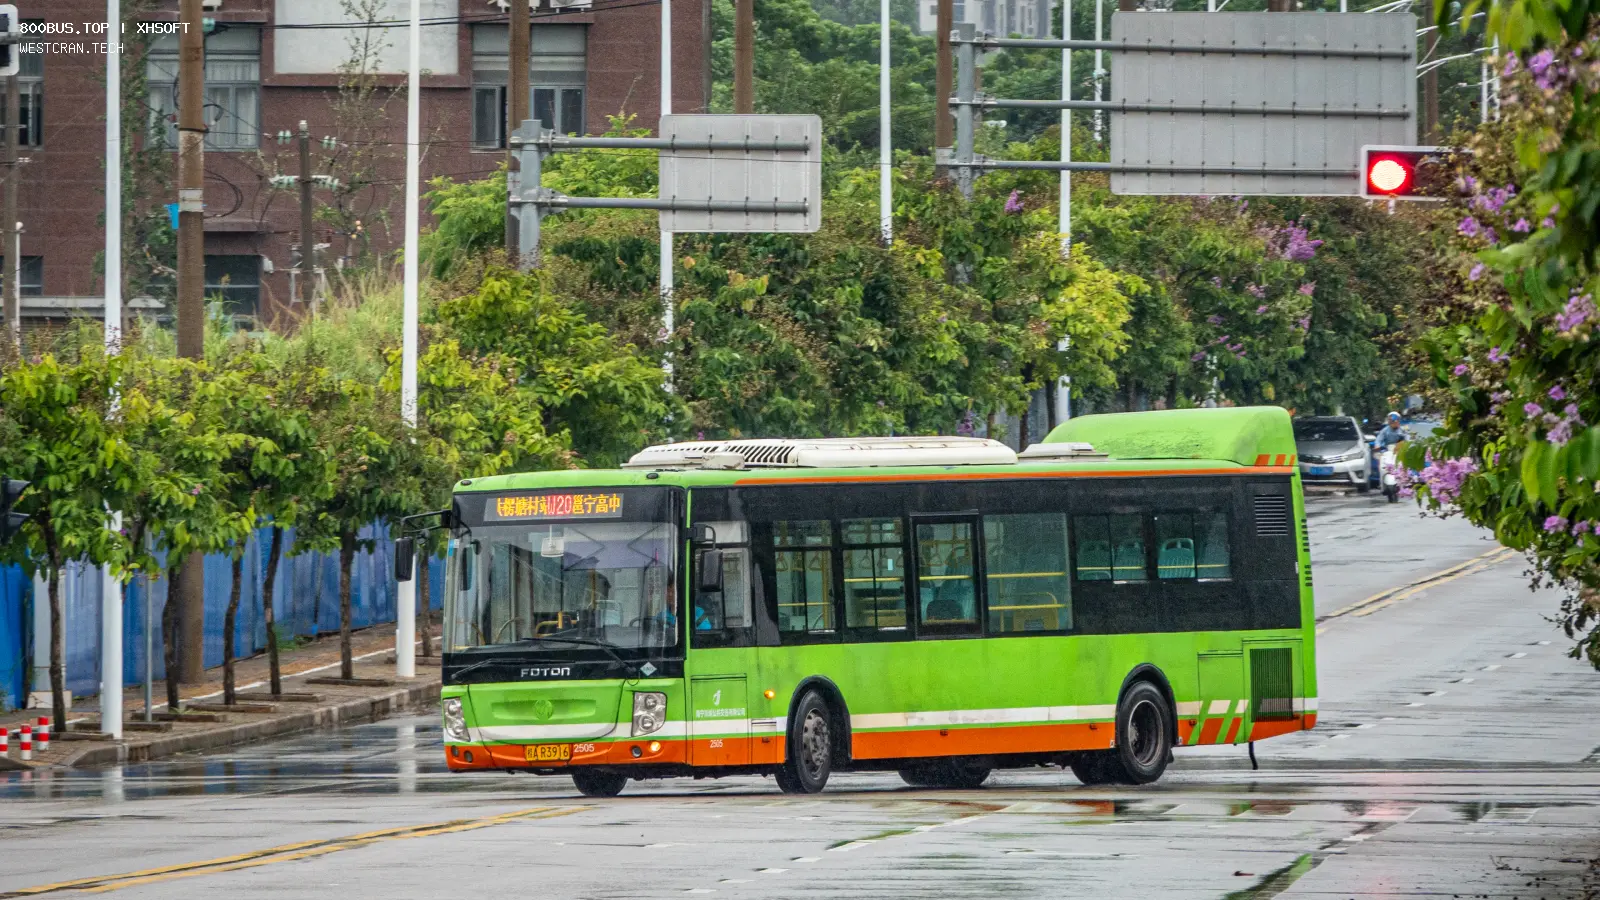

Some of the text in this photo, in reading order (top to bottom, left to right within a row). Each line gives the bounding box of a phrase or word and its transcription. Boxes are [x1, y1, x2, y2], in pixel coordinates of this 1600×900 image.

[547, 494, 572, 515] W20
[572, 493, 621, 515] 邕宁高中
[520, 667, 571, 678] FOTON
[573, 743, 595, 753] 2505
[709, 739, 723, 748] 2505
